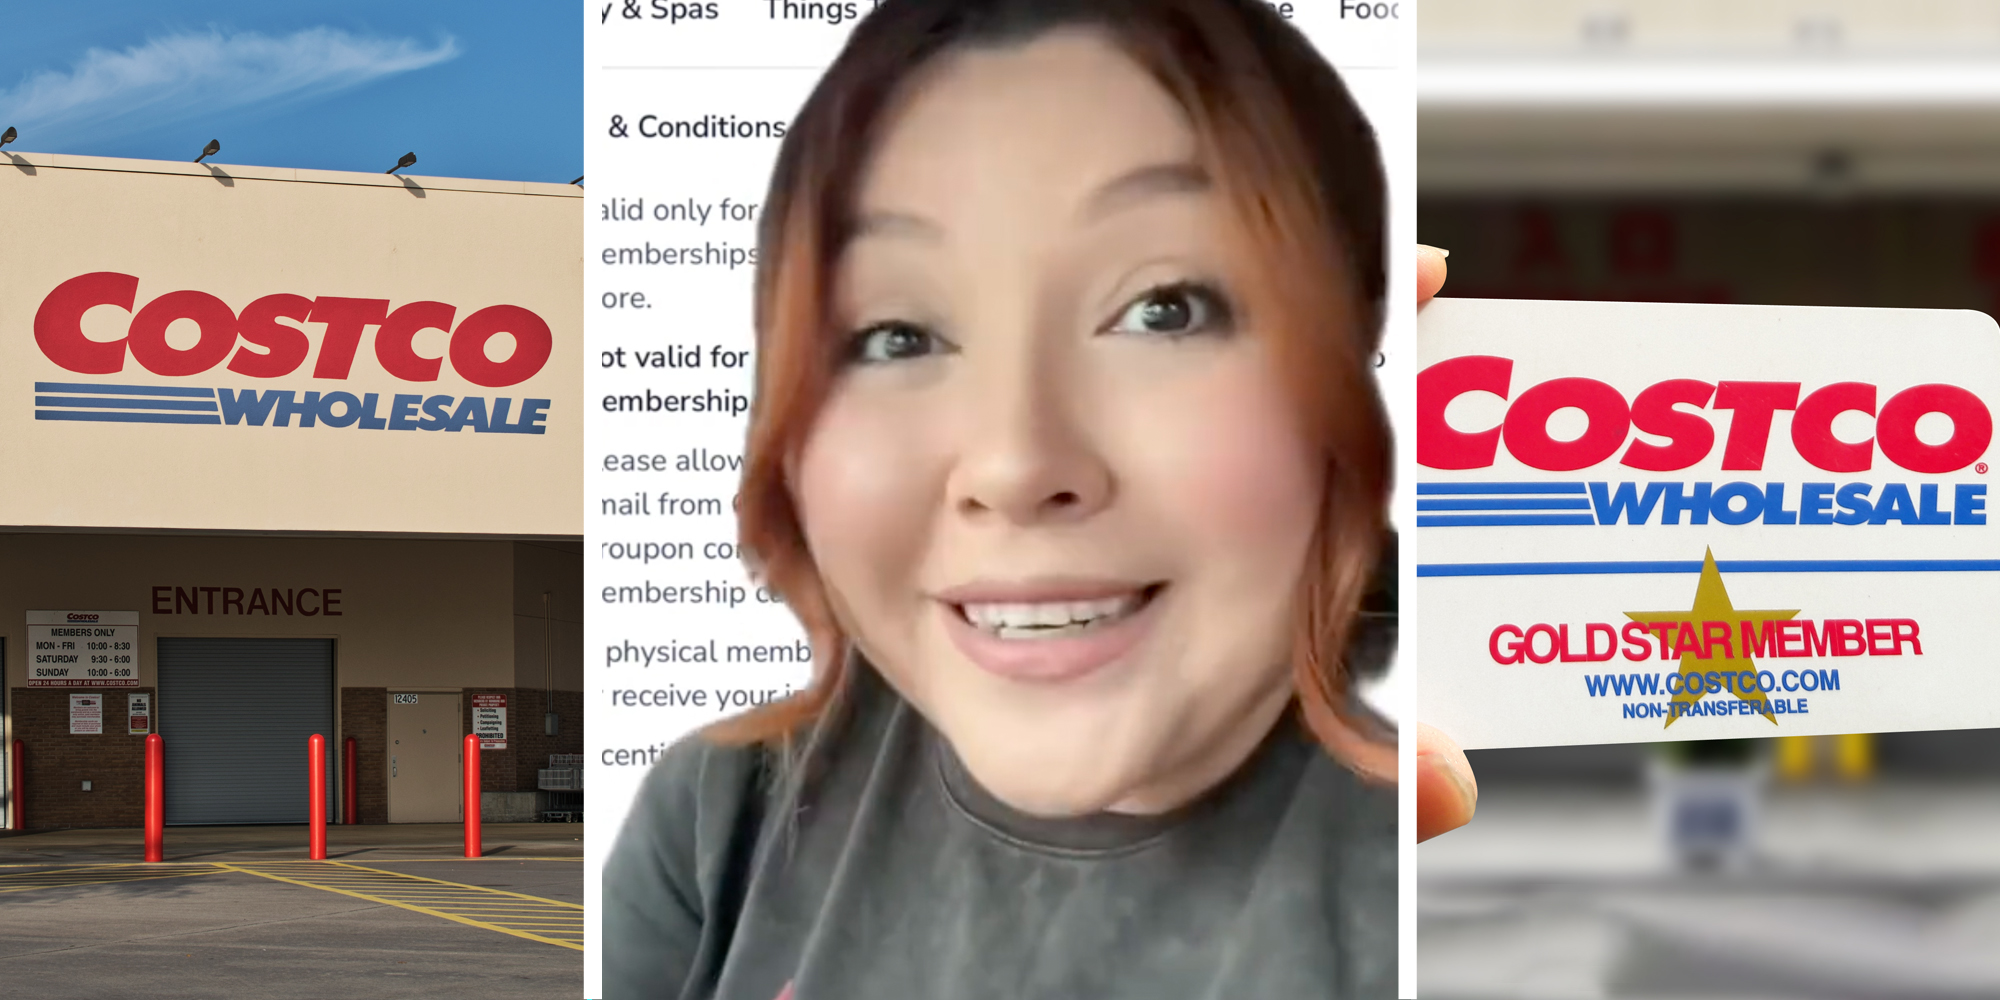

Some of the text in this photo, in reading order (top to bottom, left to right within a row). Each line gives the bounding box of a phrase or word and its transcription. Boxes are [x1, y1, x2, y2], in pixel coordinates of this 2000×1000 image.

[622, 0, 642, 19] &
[651, 0, 719, 24] Spas
[765, 0, 857, 25] Things
[608, 114, 787, 138] & Conditions
[653, 198, 712, 226] only
[720, 197, 757, 221] for
[602, 292, 652, 309] ore.
[34, 271, 552, 388] COSTCO
[634, 344, 701, 369] valid
[710, 344, 749, 369] for
[216, 387, 551, 434] WHOLESALE
[602, 388, 749, 418] embership
[1417, 354, 1993, 474] COSTCO
[658, 492, 721, 516] from
[1587, 481, 1988, 526] WHOLESALE
[152, 586, 342, 616] ENTRANCE
[602, 580, 746, 608] embership
[36, 641, 55, 650] MON
[62, 641, 75, 650] FRI
[87, 642, 107, 650] 10:00
[114, 642, 130, 650] 8:30
[51, 628, 115, 637] MEMBERS ONLY
[1488, 617, 1923, 665] GOLD STAR MEMBER
[36, 655, 78, 663] SATURDAY
[91, 655, 107, 663] 9:30
[114, 655, 130, 663] 6:00
[606, 639, 718, 668] physical
[36, 668, 69, 677] SUNDAY
[87, 668, 107, 677] 10:00
[114, 668, 131, 677] 6:00
[1585, 669, 1841, 698] WWW.COSTCO.COM
[395, 694, 417, 704] 12405
[612, 683, 707, 707] receive
[716, 689, 777, 712] your
[1622, 698, 1809, 719] NON-TRANSFERABLE
